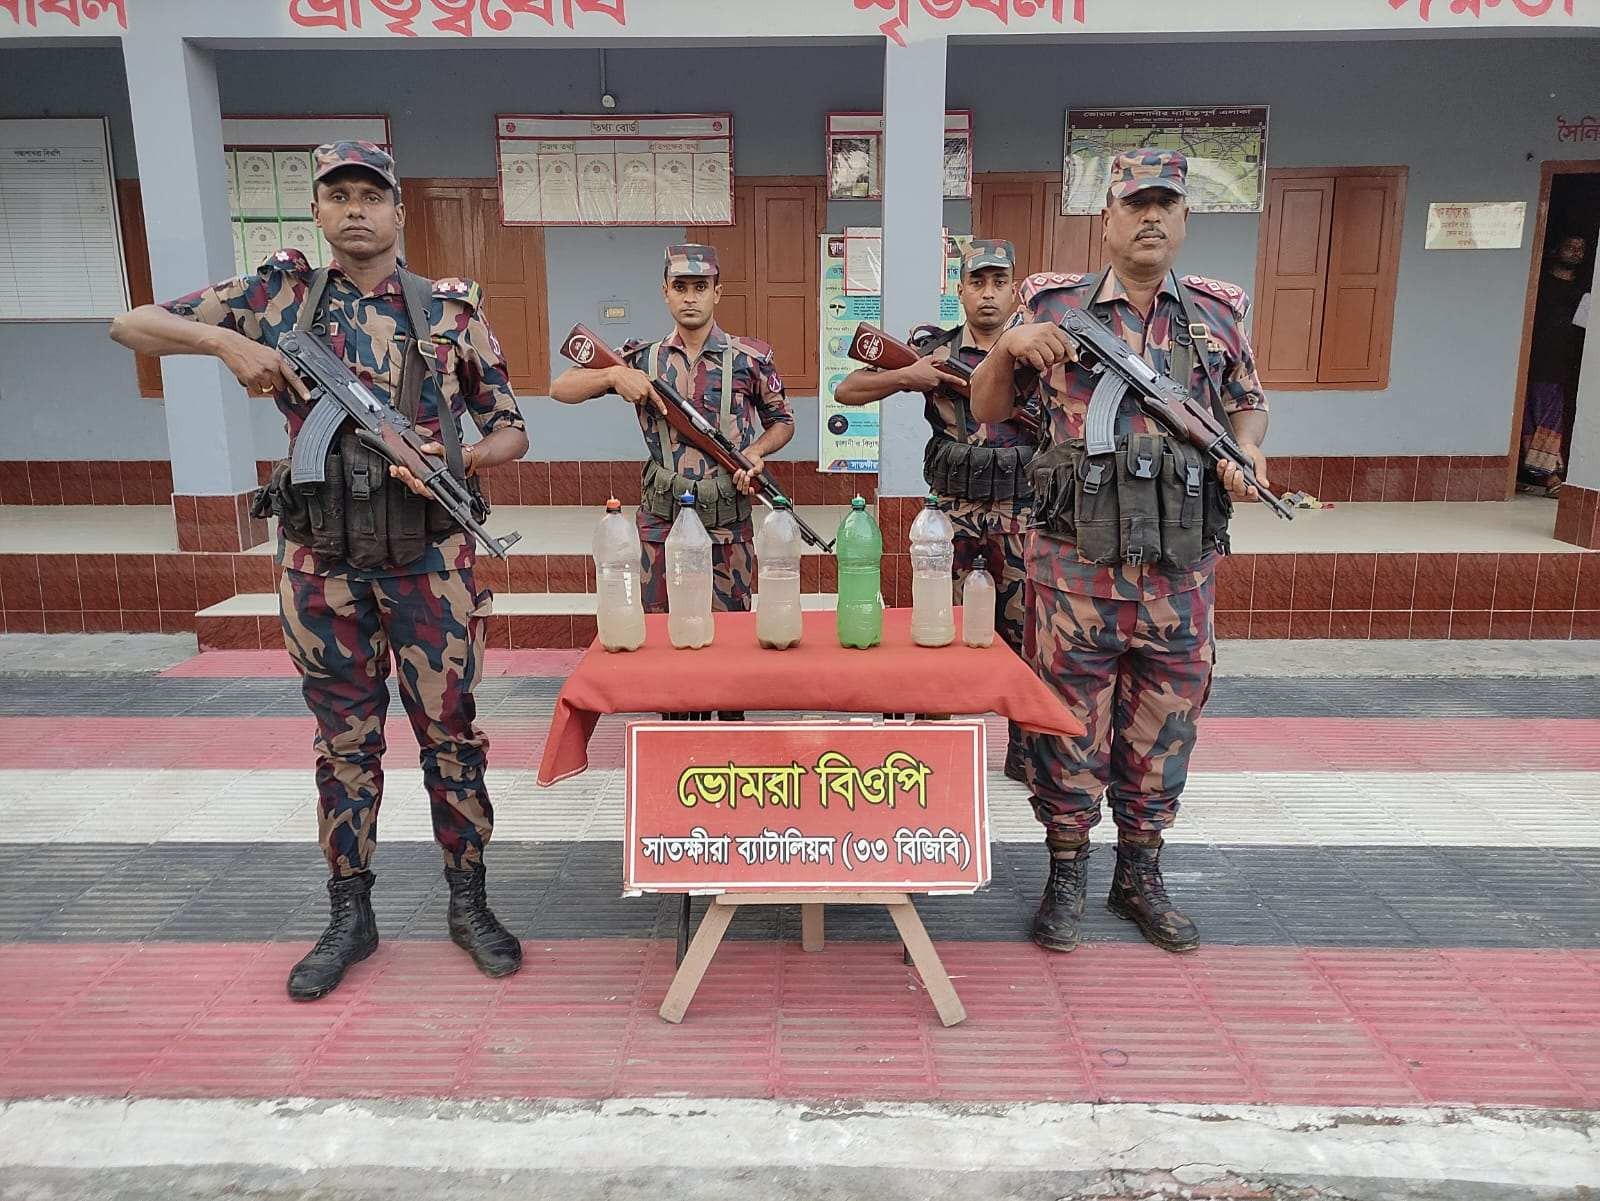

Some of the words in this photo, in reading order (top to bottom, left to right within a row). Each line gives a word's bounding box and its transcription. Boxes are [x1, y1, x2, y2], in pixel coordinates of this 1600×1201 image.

[677, 760, 806, 808] ভোমরা
[813, 750, 932, 810] বিওপি
[641, 826, 731, 865] সাতক্ষীরা
[735, 827, 836, 866] ব্যাটালিয়ন
[840, 832, 888, 871] (৩৩
[893, 827, 972, 871] বিজিবি)
